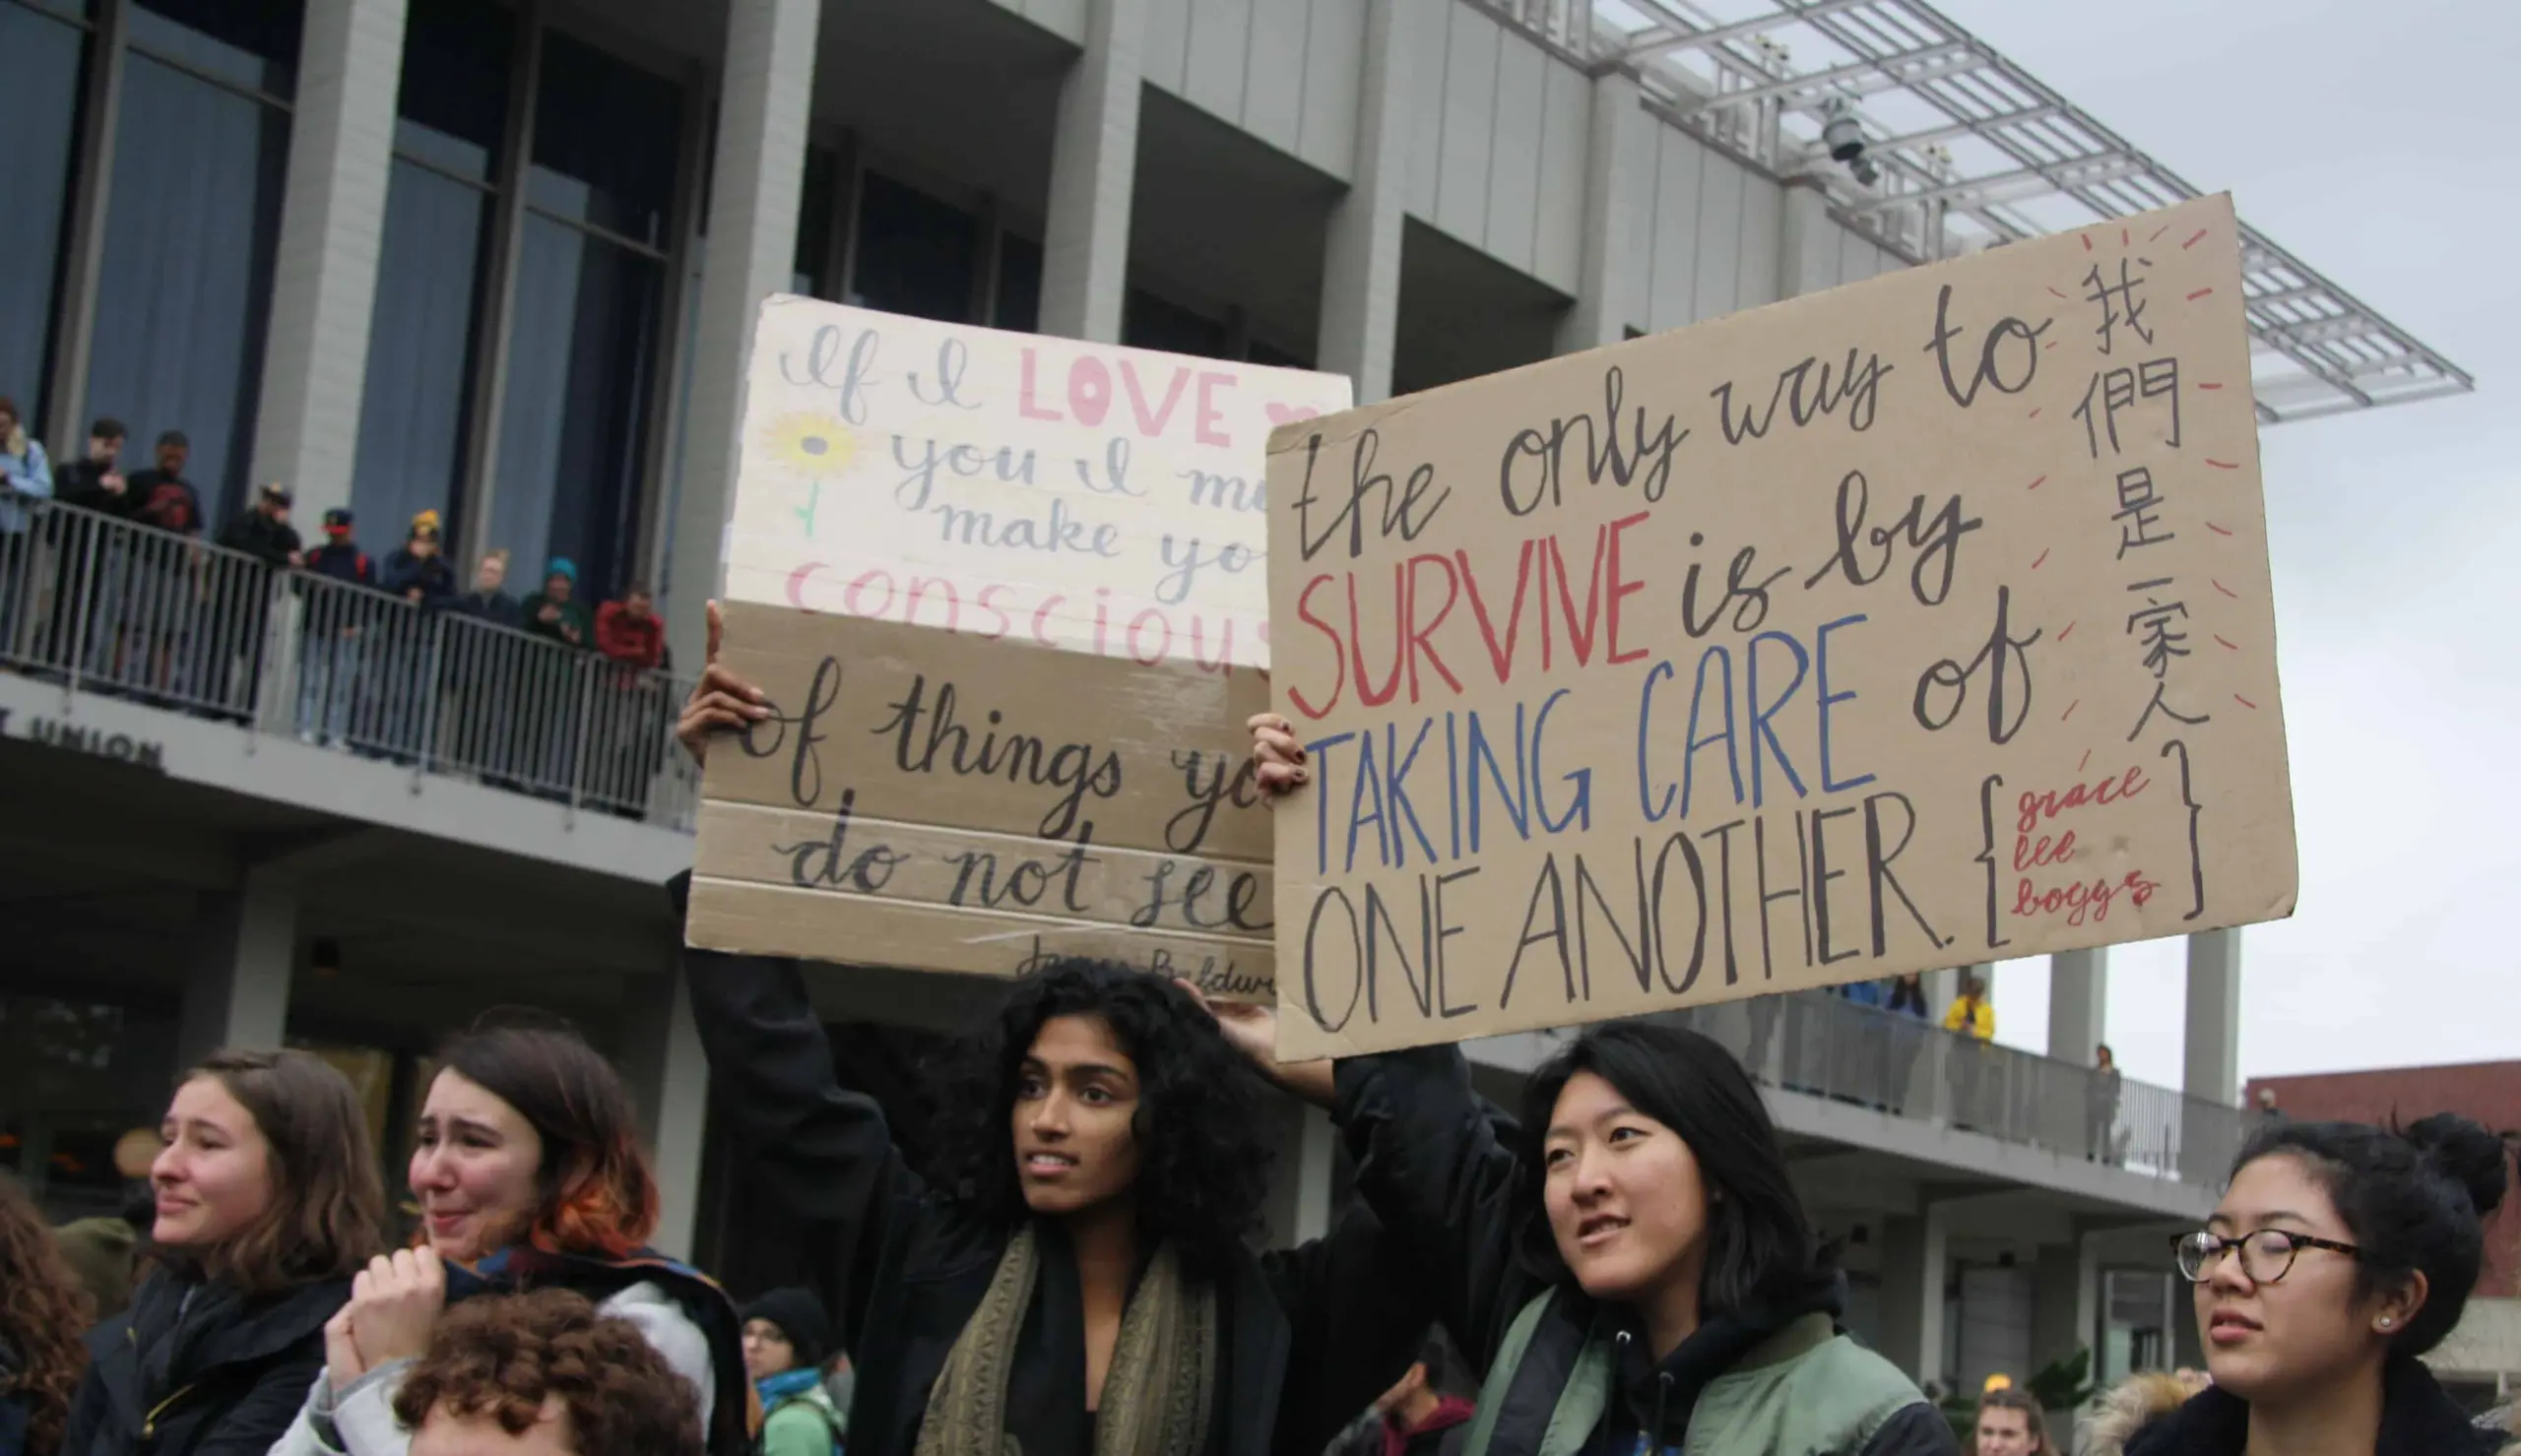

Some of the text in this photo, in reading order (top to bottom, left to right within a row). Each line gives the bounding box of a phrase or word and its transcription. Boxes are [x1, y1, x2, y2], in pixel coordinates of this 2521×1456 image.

[778, 324, 1239, 448] If I LOVE
[1291, 284, 2053, 561] the only way to
[890, 434, 1037, 512] you
[1073, 436, 1150, 498] I
[2072, 257, 2211, 742] 我們是一家人
[930, 498, 1268, 606] make yo
[1287, 469, 1984, 721] SURVIVE is by
[29, 716, 166, 771] UNION
[739, 656, 1260, 855] of things yo
[1304, 586, 2043, 877] TAKING CARE of
[771, 788, 1275, 931] do not see
[2012, 830, 2077, 872] lee
[2016, 765, 2152, 834] grace
[1303, 791, 1956, 1034] ONE ANOTHER.
[2010, 869, 2162, 926] boggs
